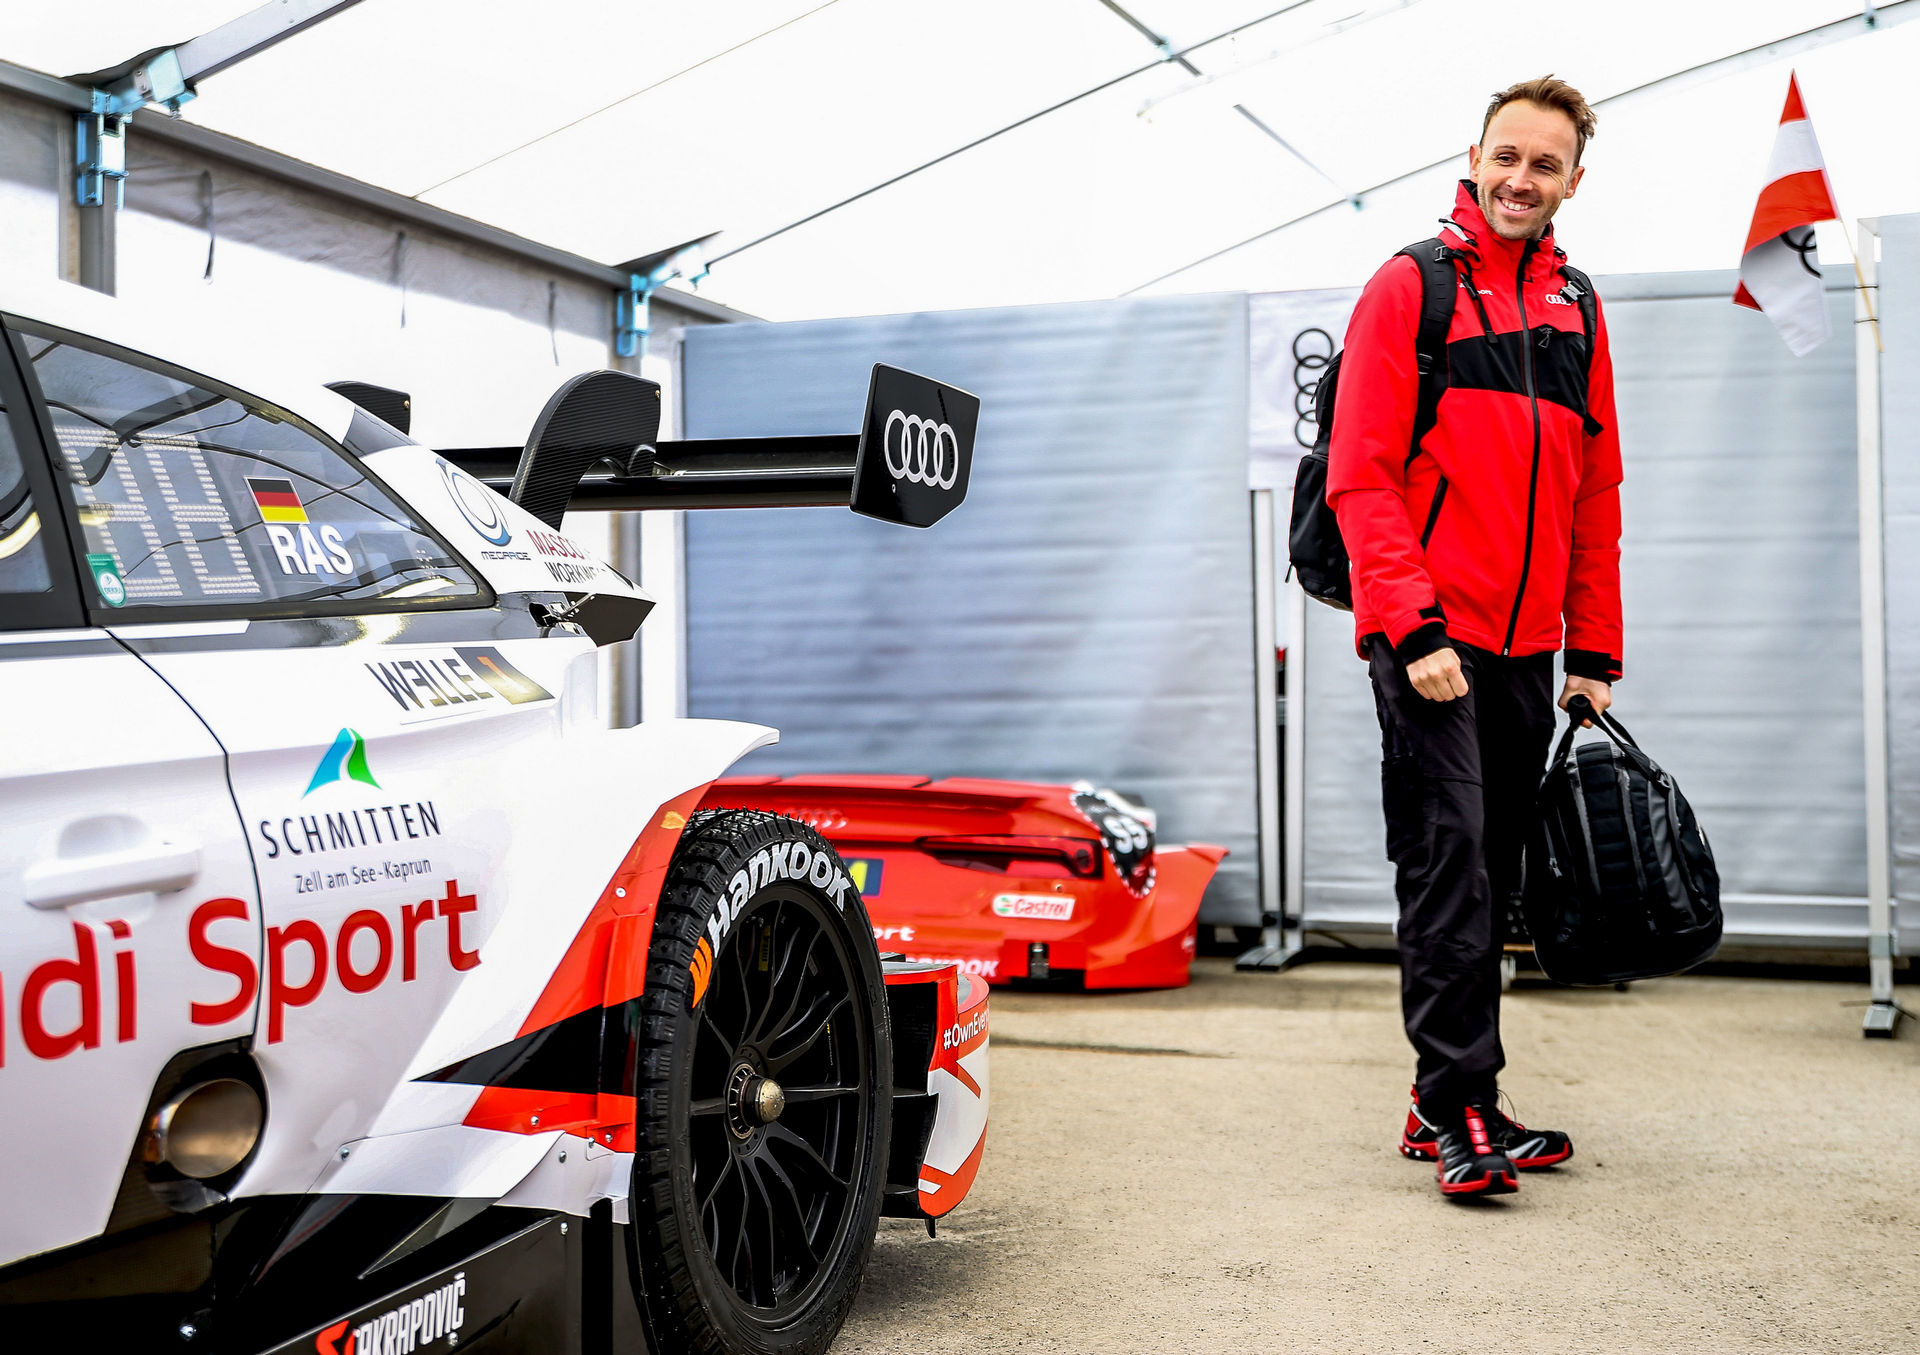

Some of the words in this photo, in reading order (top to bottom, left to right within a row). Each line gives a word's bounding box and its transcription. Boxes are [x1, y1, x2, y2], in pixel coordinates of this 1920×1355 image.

[264, 524, 354, 575] RAS
[526, 530, 592, 560] MASCO
[364, 659, 494, 711] WELLE
[260, 801, 441, 858] SCHMITTEN
[296, 871, 323, 894] Zell
[328, 873, 349, 889] am
[353, 859, 432, 885] See-Kaprun
[1014, 898, 1069, 917] Castrol
[873, 926, 915, 941] ort
[0, 919, 136, 1067] di
[187, 880, 481, 1044] Sport
